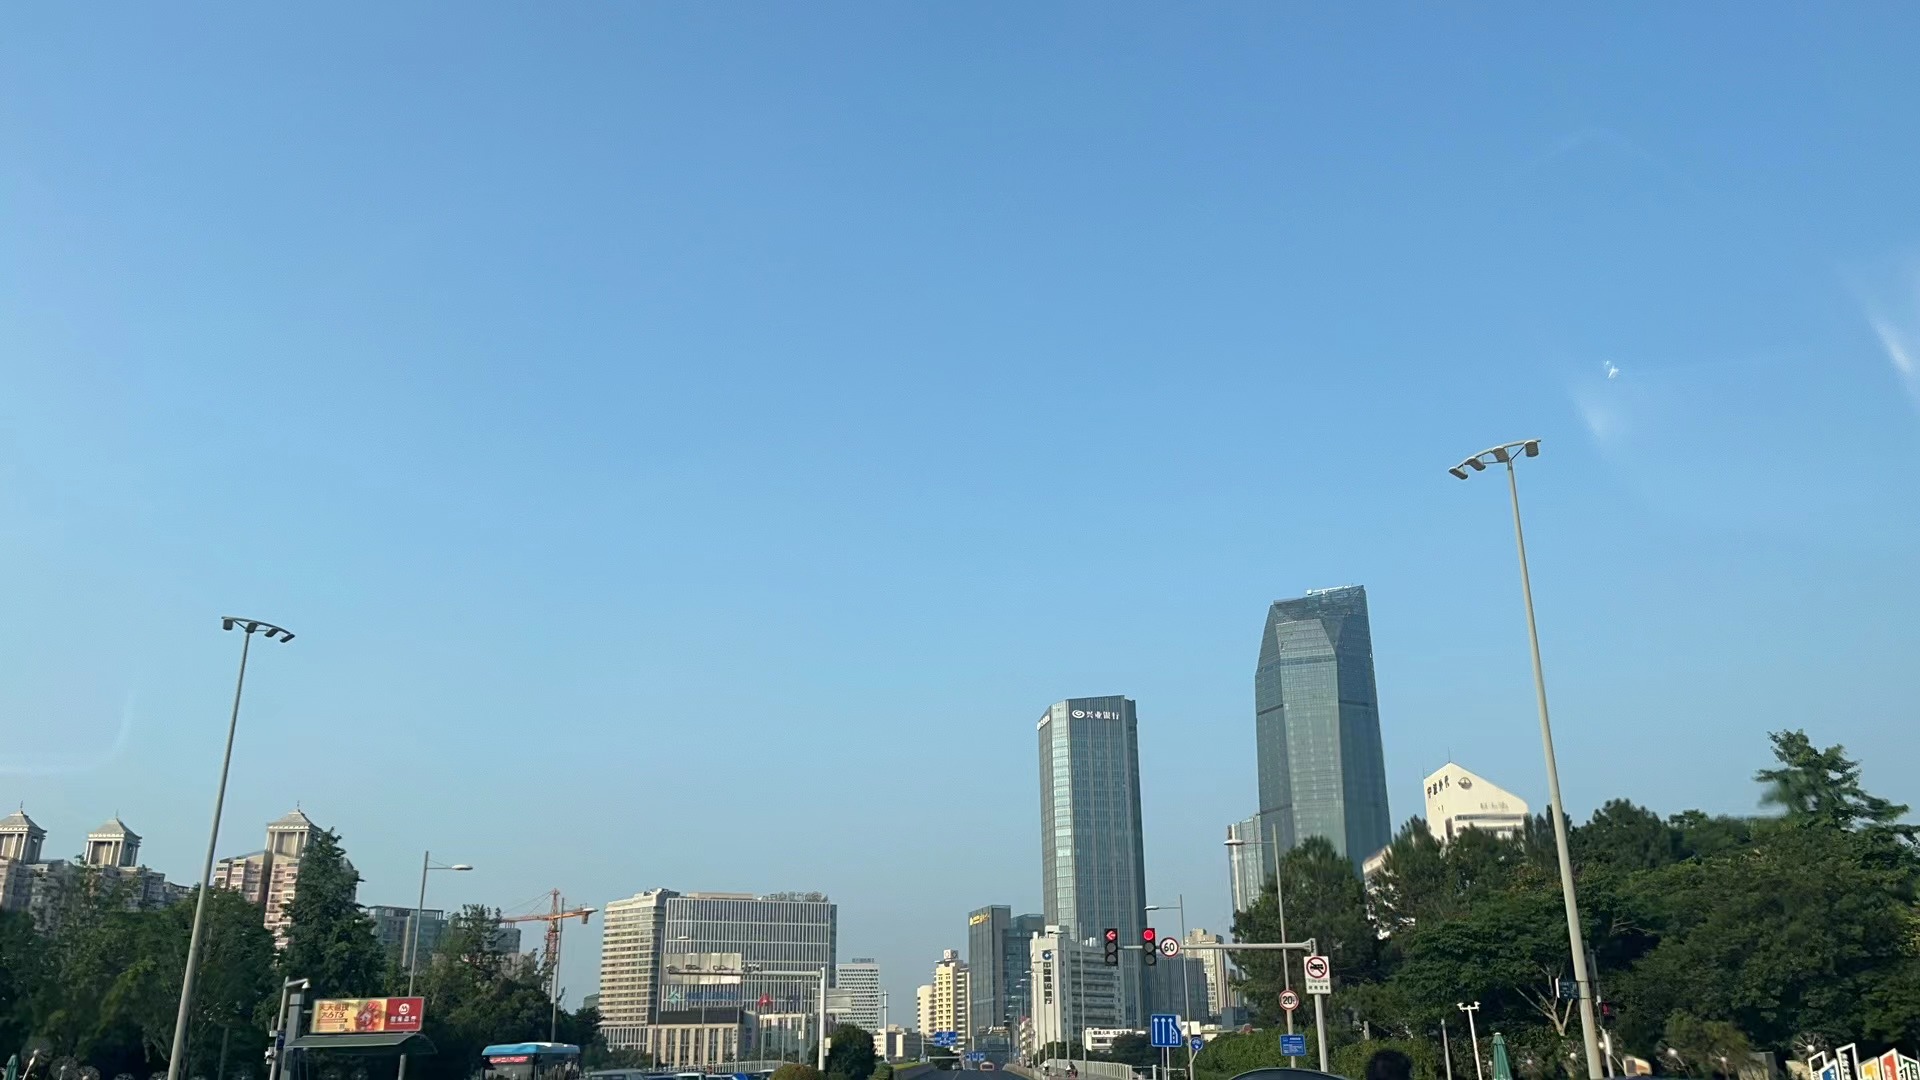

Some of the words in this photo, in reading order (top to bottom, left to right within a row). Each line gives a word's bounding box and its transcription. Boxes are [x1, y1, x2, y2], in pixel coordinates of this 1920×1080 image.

[1086, 711, 1119, 720] 兴业银行
[1164, 942, 1175, 952] 60
